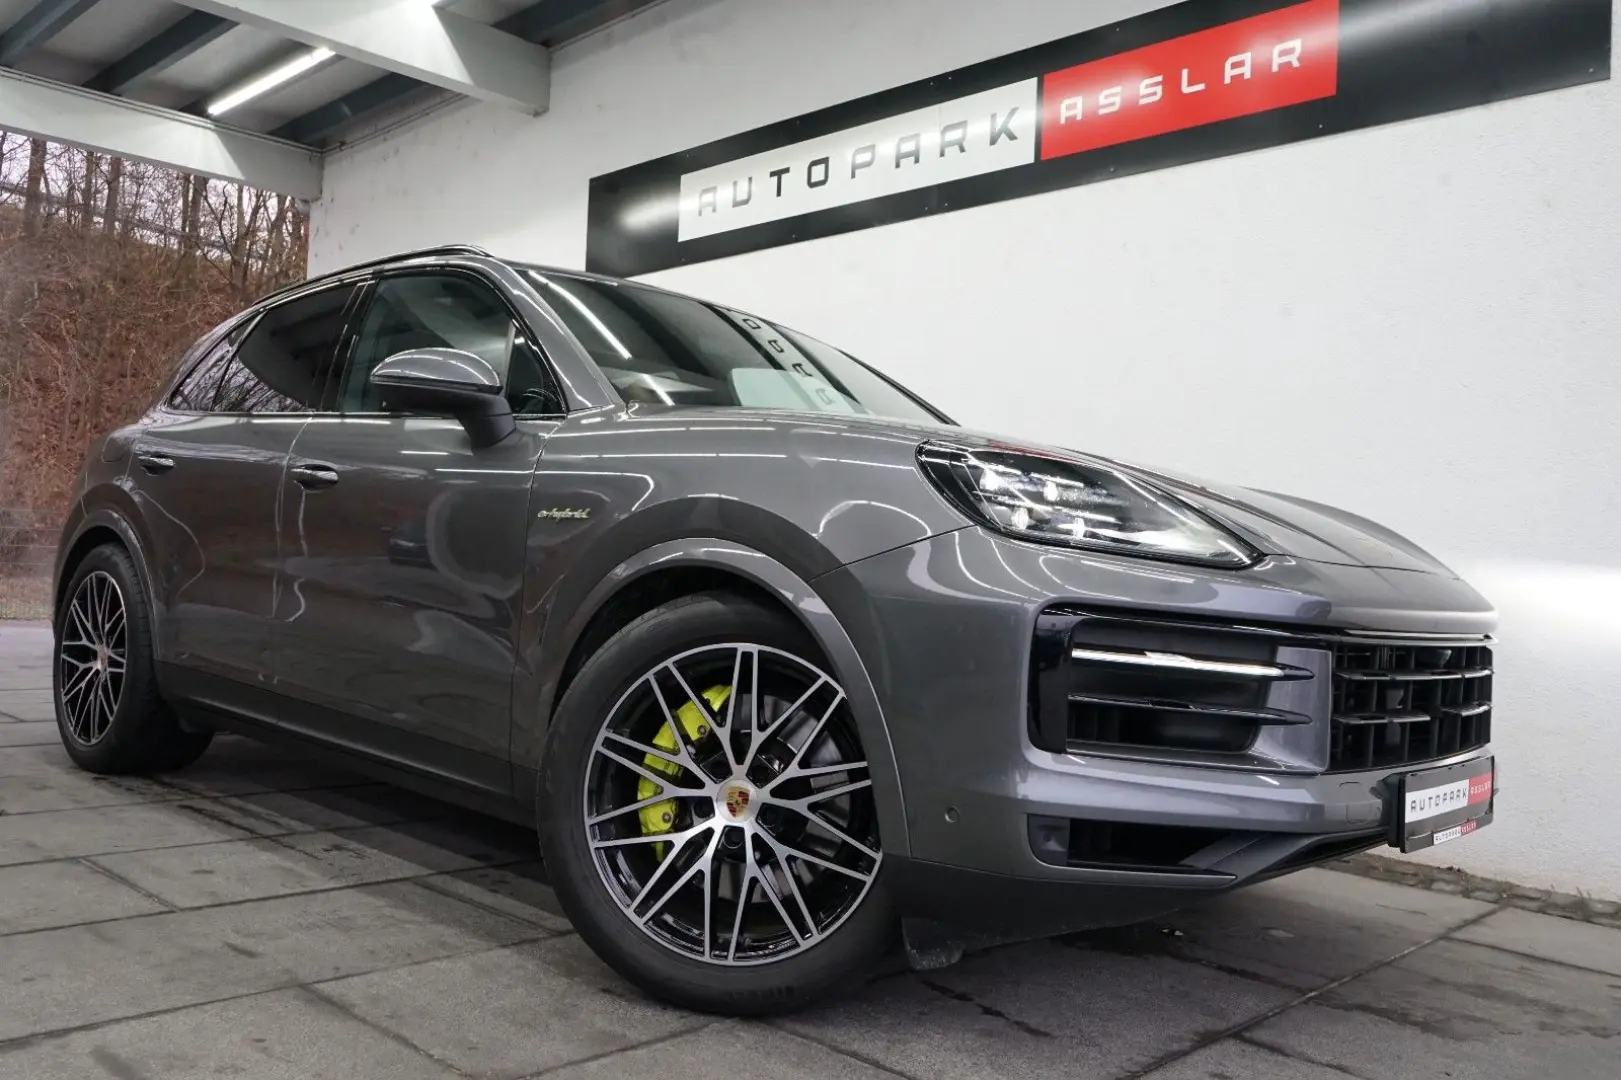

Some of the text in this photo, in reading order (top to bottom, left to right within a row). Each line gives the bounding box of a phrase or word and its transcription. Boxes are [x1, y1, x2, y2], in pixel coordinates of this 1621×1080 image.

[698, 39, 1302, 216] AUTOPARK ASSLAR
[1410, 788, 1467, 813] AUTOPARK
